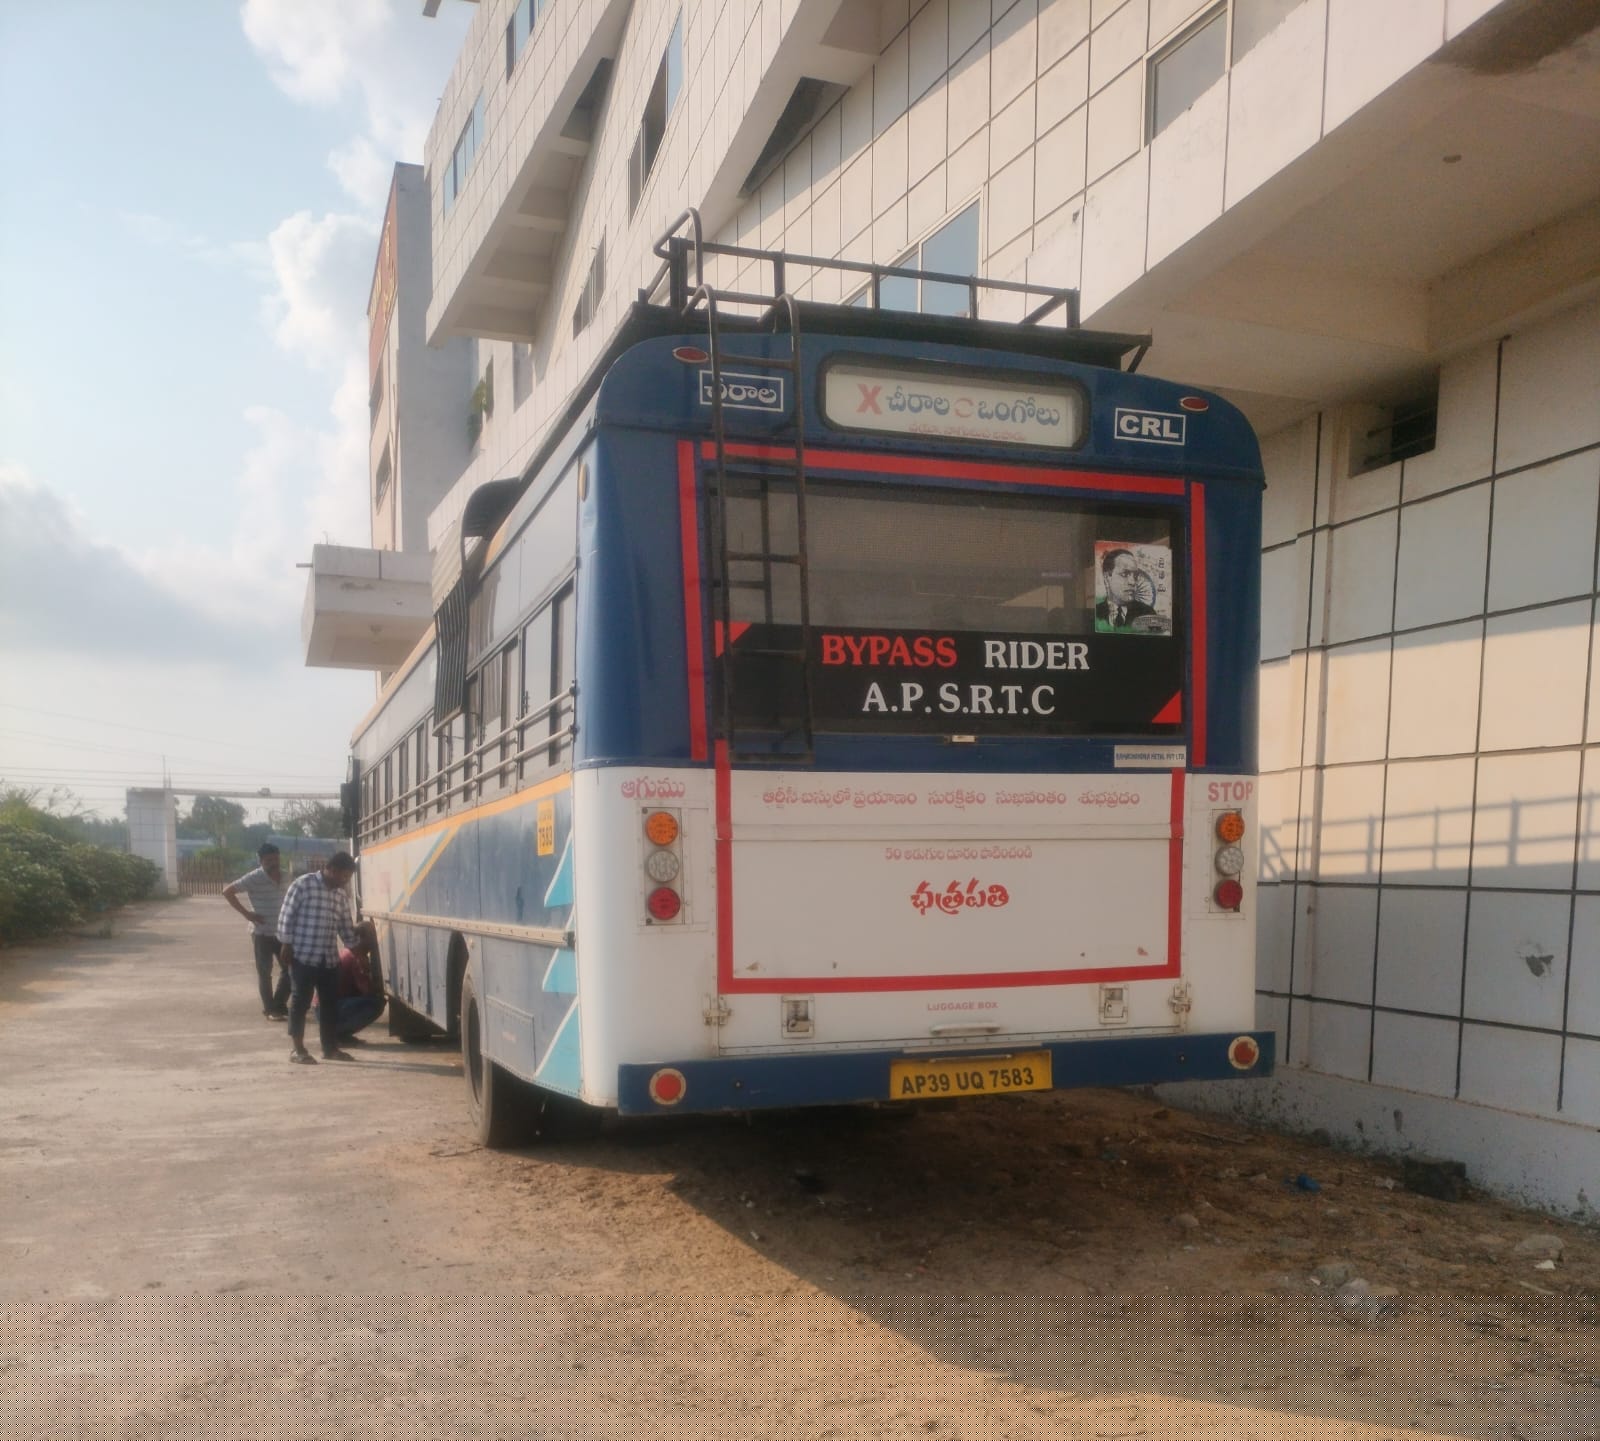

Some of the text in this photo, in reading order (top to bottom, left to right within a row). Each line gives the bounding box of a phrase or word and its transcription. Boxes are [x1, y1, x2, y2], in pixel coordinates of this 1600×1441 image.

[856, 383, 1061, 426] X చీరాల ఒంగోలు
[1119, 415, 1180, 439] CRL
[821, 635, 1090, 670] BYPASS RIDER
[621, 776, 685, 798] ఆగుము
[1207, 781, 1254, 802] STOP
[853, 790, 918, 809] ప్రయాణం
[927, 789, 987, 810] సురక్షితం
[885, 847, 901, 861] 50
[911, 877, 1010, 915] ఛత్రపతి
[927, 1001, 999, 1012] LUGGAGE BOX
[901, 1067, 1034, 1095] AP39 UQ 7583
